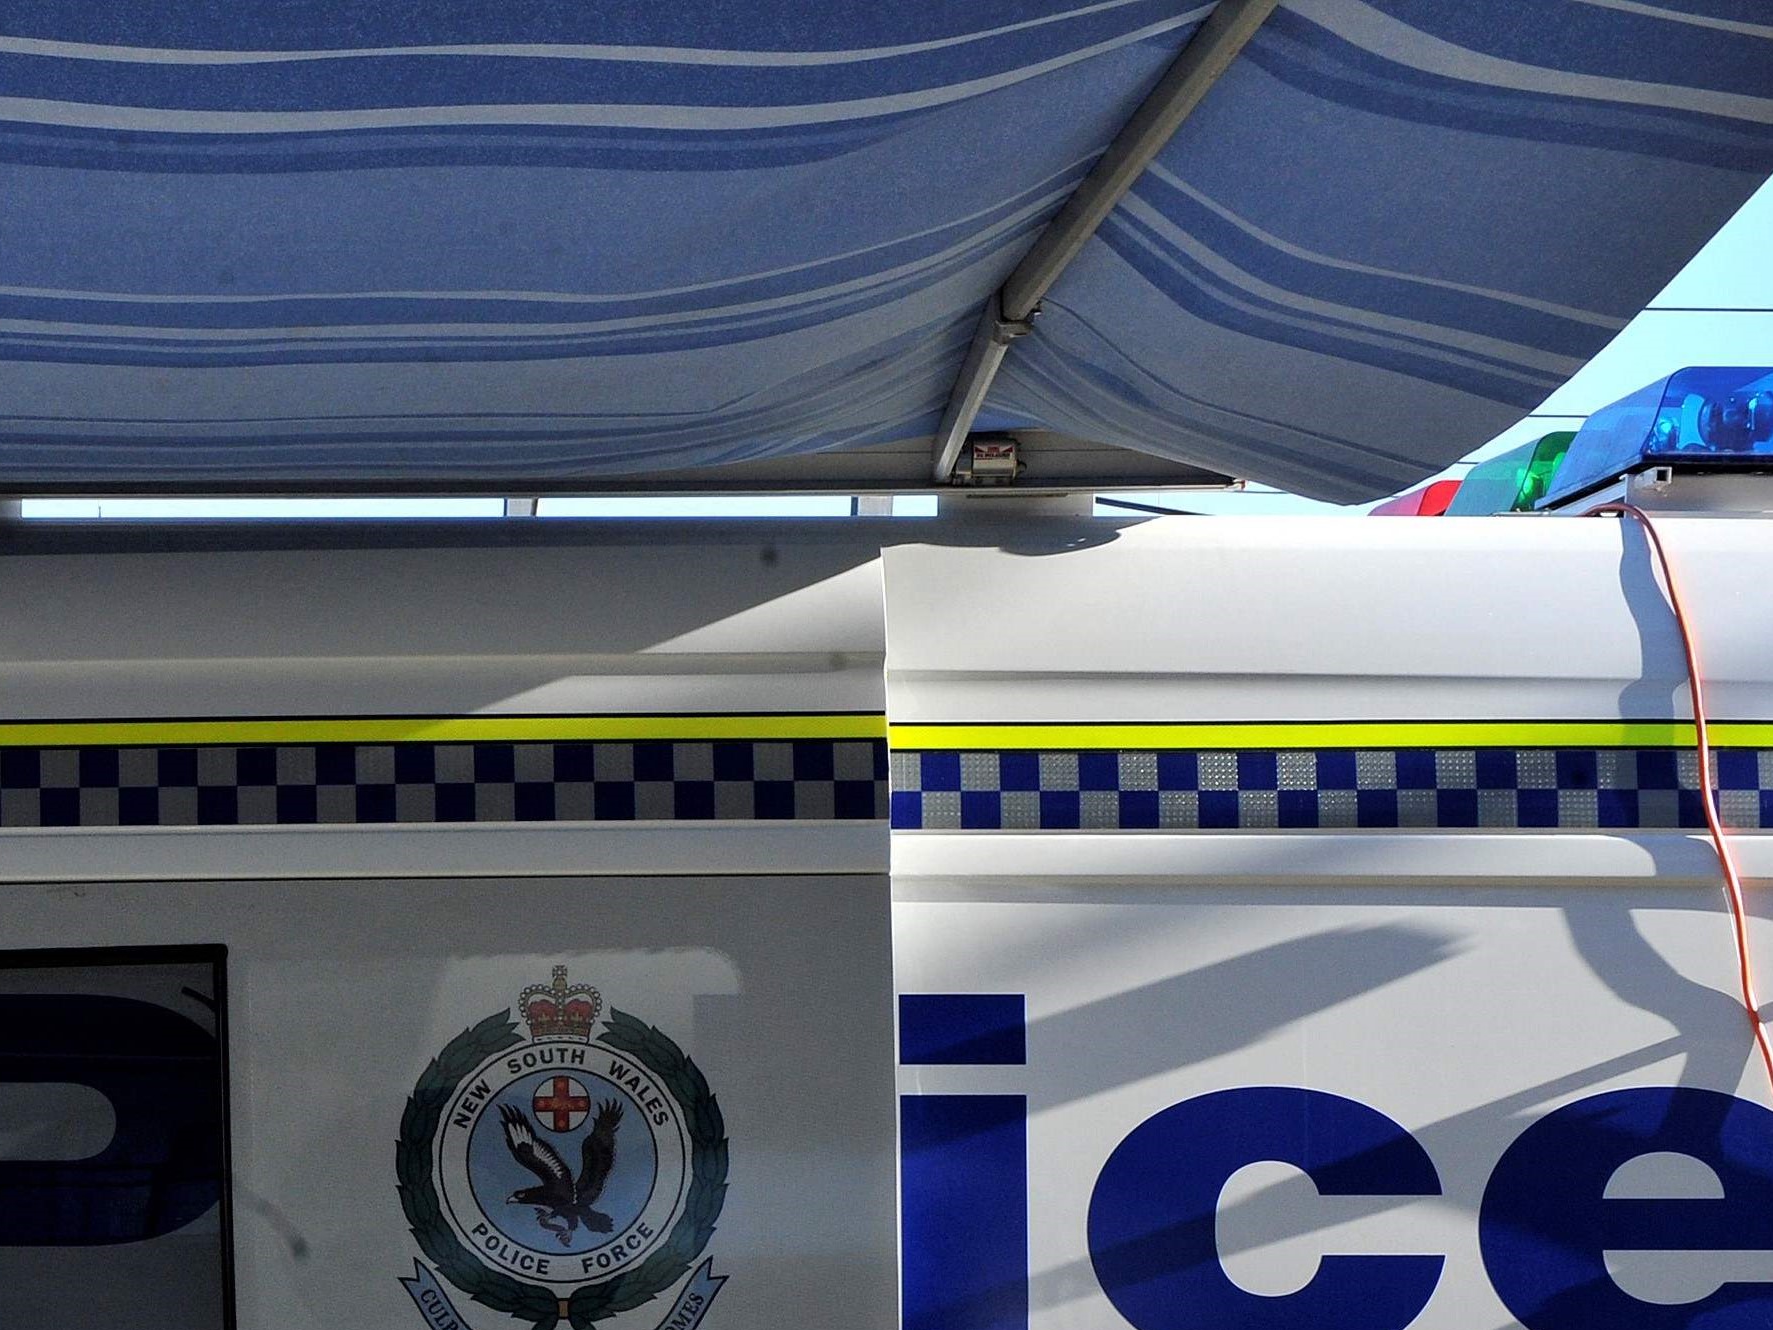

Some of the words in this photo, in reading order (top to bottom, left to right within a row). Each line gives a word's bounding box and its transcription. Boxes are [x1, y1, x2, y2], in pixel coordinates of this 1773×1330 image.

[453, 1081, 492, 1131] NEW
[507, 1047, 586, 1075] SOUTH
[608, 1060, 669, 1127] WALES
[471, 1222, 550, 1275] POLICE
[582, 1221, 655, 1274] FORCE
